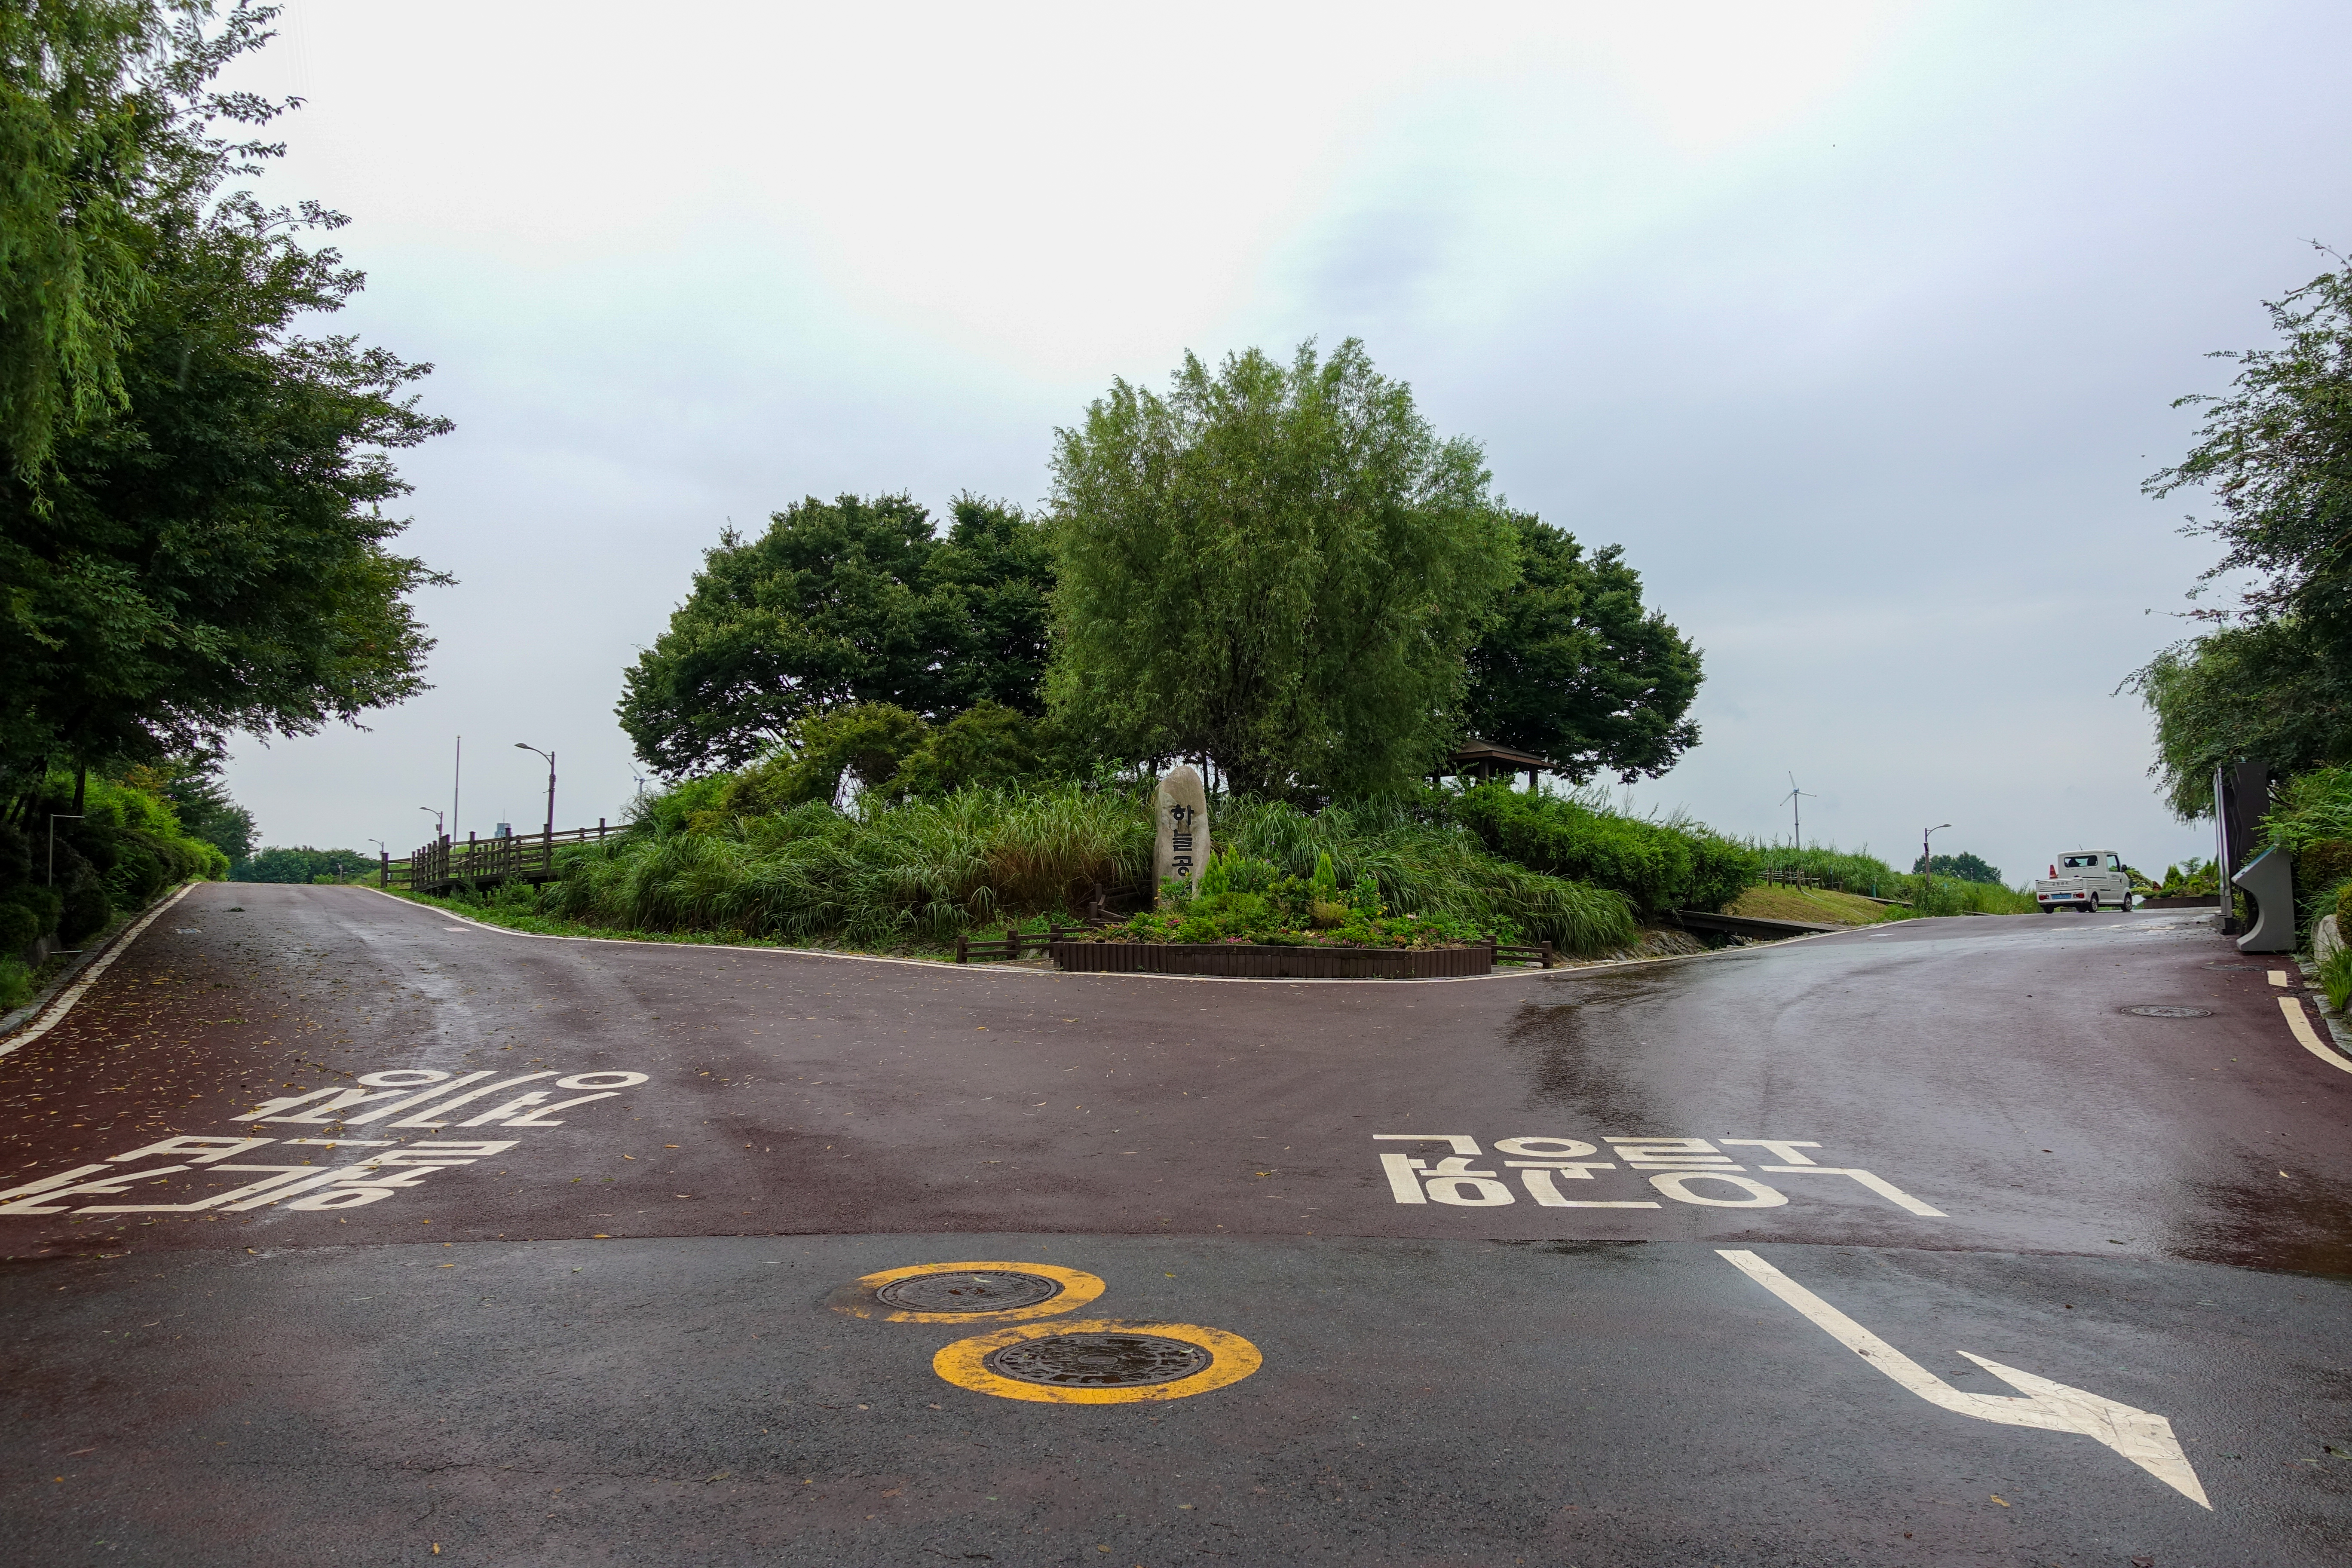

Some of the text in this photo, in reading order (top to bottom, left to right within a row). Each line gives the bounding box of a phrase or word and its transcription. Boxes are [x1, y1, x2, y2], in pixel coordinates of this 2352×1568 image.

[1170, 804, 1194, 895] 하늘공
[230, 1069, 649, 1127] 경기장
[0, 1136, 521, 1215] 월드컵
[1372, 1134, 1950, 1217] 노을공원
